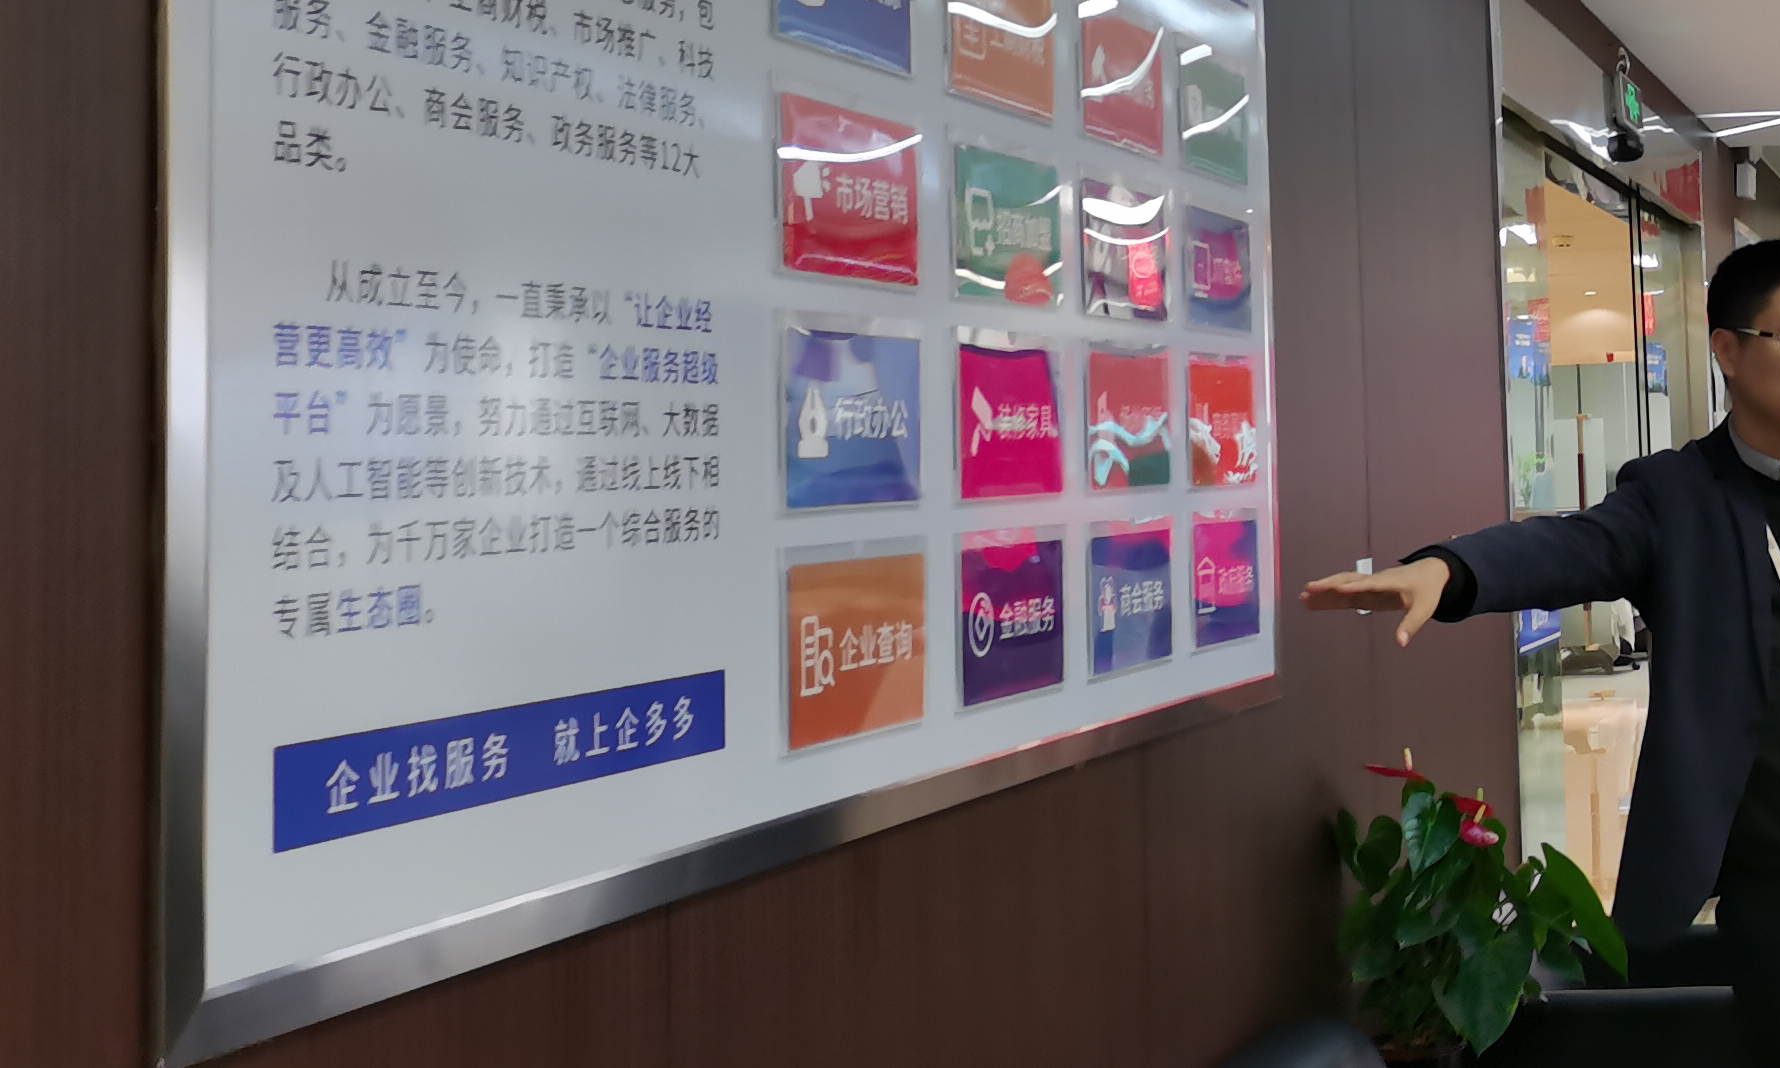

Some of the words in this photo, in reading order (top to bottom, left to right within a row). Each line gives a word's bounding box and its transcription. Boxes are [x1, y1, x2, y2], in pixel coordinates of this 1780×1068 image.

[273, 51, 700, 179] 行政办公、商会服务、政务服务等12大
[273, 119, 348, 173] 品类。
[834, 173, 910, 225] 市场营销
[833, 396, 909, 440] 行政办公
[271, 455, 721, 503] 及人工智能等创新技术，通过线上线下相
[271, 505, 721, 571] 结合，为千万家企业打造一个综合服务的
[273, 582, 436, 638] 专属生态圈。
[998, 595, 1056, 641] 金融服务
[838, 620, 913, 672] 企业查询
[325, 731, 510, 815] 企业找服务
[552, 695, 695, 766] 就上企多多
